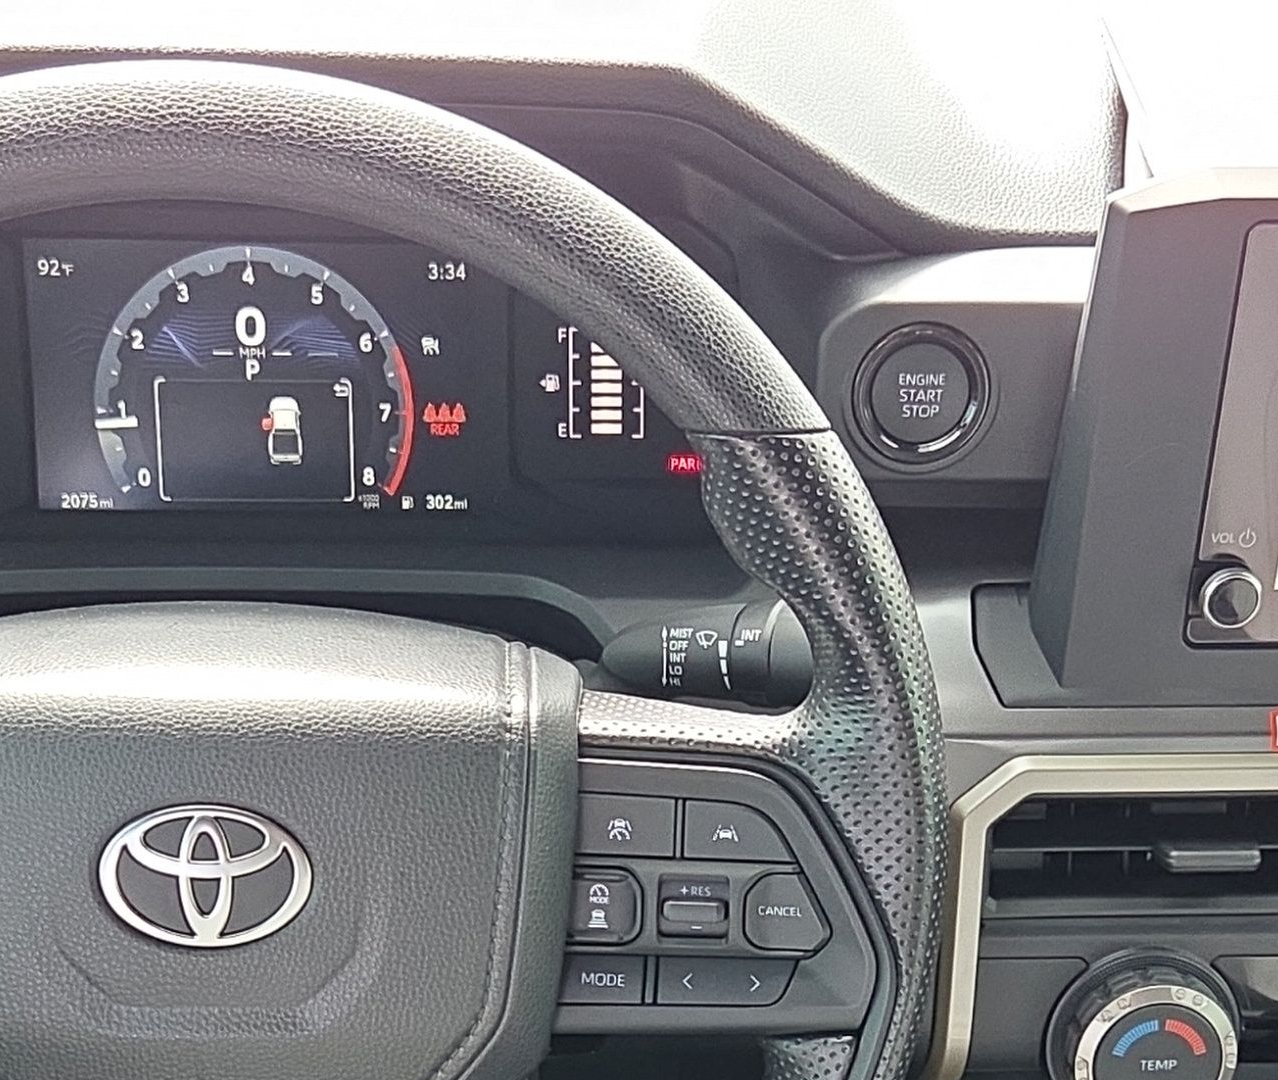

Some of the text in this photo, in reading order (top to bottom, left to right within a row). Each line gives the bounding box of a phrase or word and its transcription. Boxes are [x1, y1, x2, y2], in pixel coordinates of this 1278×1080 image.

[242, 267, 255, 285] 4
[428, 262, 466, 281] 3:34
[177, 284, 189, 303] 3
[311, 285, 323, 305] 5
[235, 307, 266, 347] 0
[131, 330, 145, 349] 2
[359, 333, 373, 353] 6
[558, 328, 568, 344] F
[239, 347, 265, 359] MPH
[245, 361, 260, 380] P
[898, 373, 945, 386] ENGINE
[899, 389, 943, 402] START
[379, 403, 391, 422] 7
[902, 405, 939, 418] STOP
[430, 423, 459, 436] REAR
[558, 423, 567, 438] E
[138, 470, 150, 487] 0
[362, 466, 375, 486] 8
[1211, 532, 1235, 544] VOL
[669, 627, 693, 638] MIST
[741, 629, 762, 642] INT
[669, 641, 688, 651] OFF
[670, 652, 686, 663] INT
[669, 665, 682, 675] LO
[589, 896, 609, 904] MODE
[758, 905, 802, 918] CANCEL
[581, 972, 625, 987] MODE
[1140, 1059, 1178, 1071] TEMP
